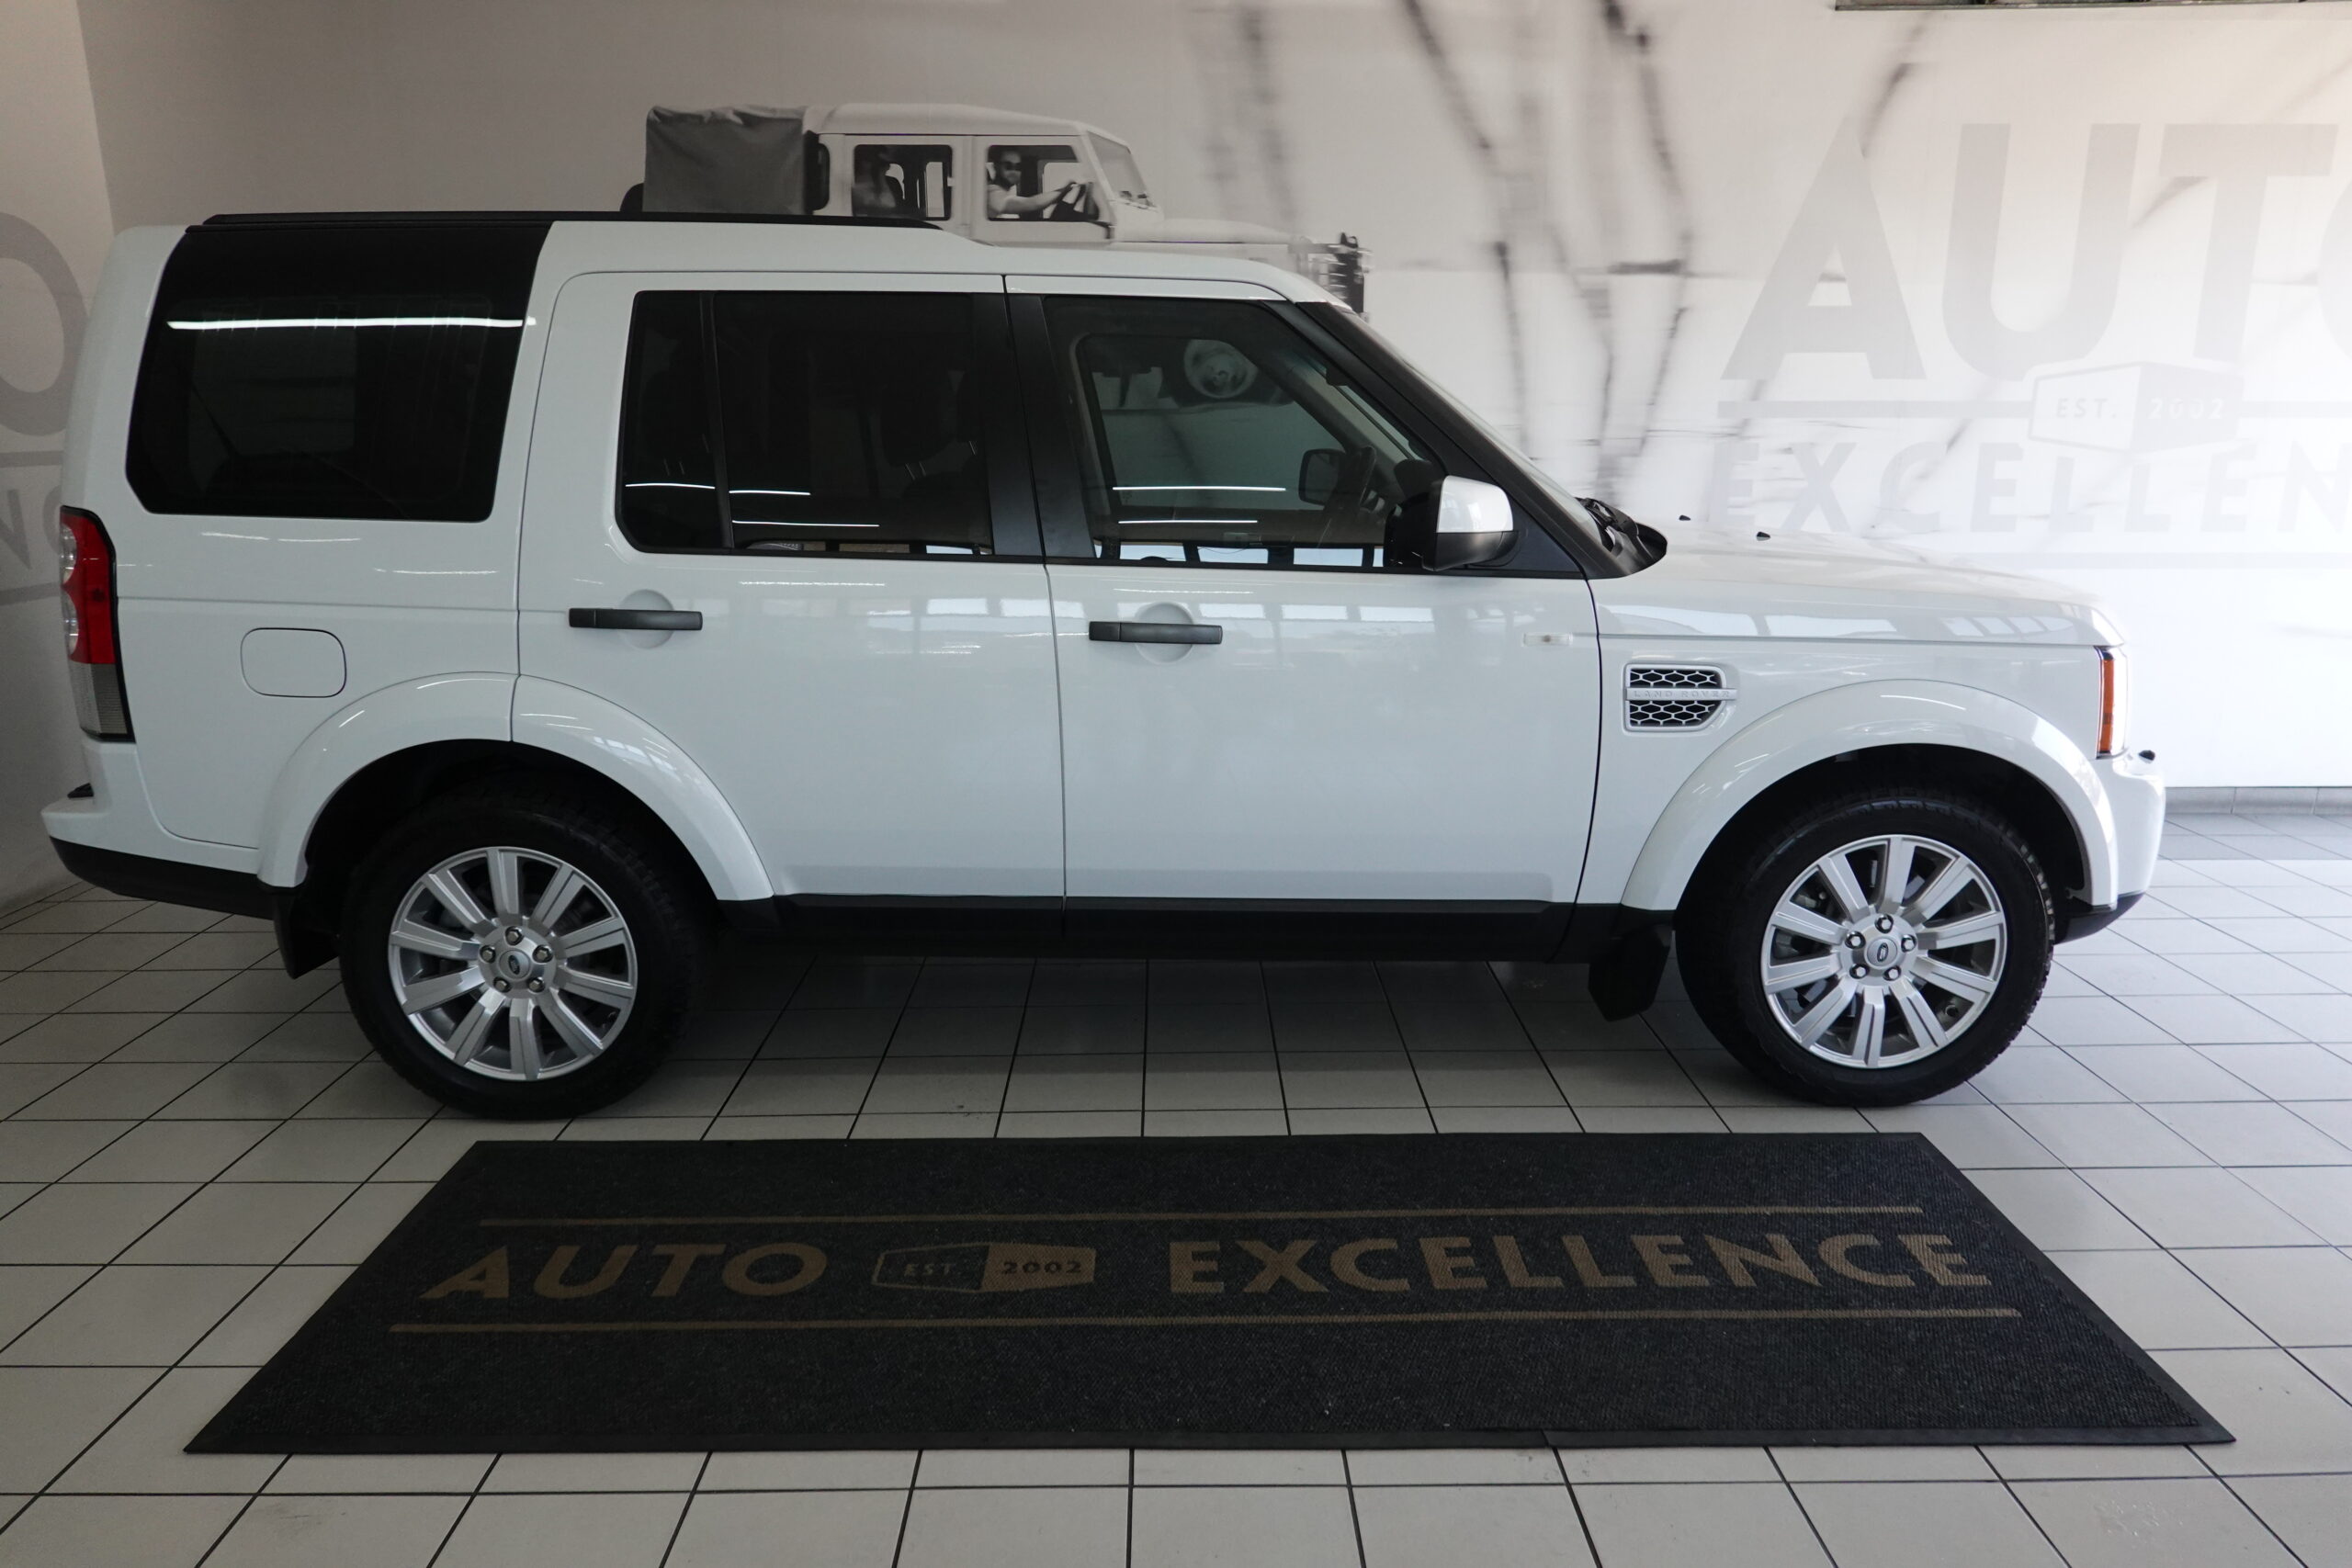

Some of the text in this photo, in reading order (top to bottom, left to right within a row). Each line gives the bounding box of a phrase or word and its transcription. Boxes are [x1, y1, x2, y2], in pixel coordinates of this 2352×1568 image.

[1719, 116, 2352, 381] AUT
[2056, 397, 2225, 420] EST. 2002
[1634, 690, 1730, 698] LAND ROVER
[418, 1242, 828, 1299] AUTO
[1001, 1260, 1082, 1276] 2002
[1169, 1233, 1993, 1294] EXCELLENCE
